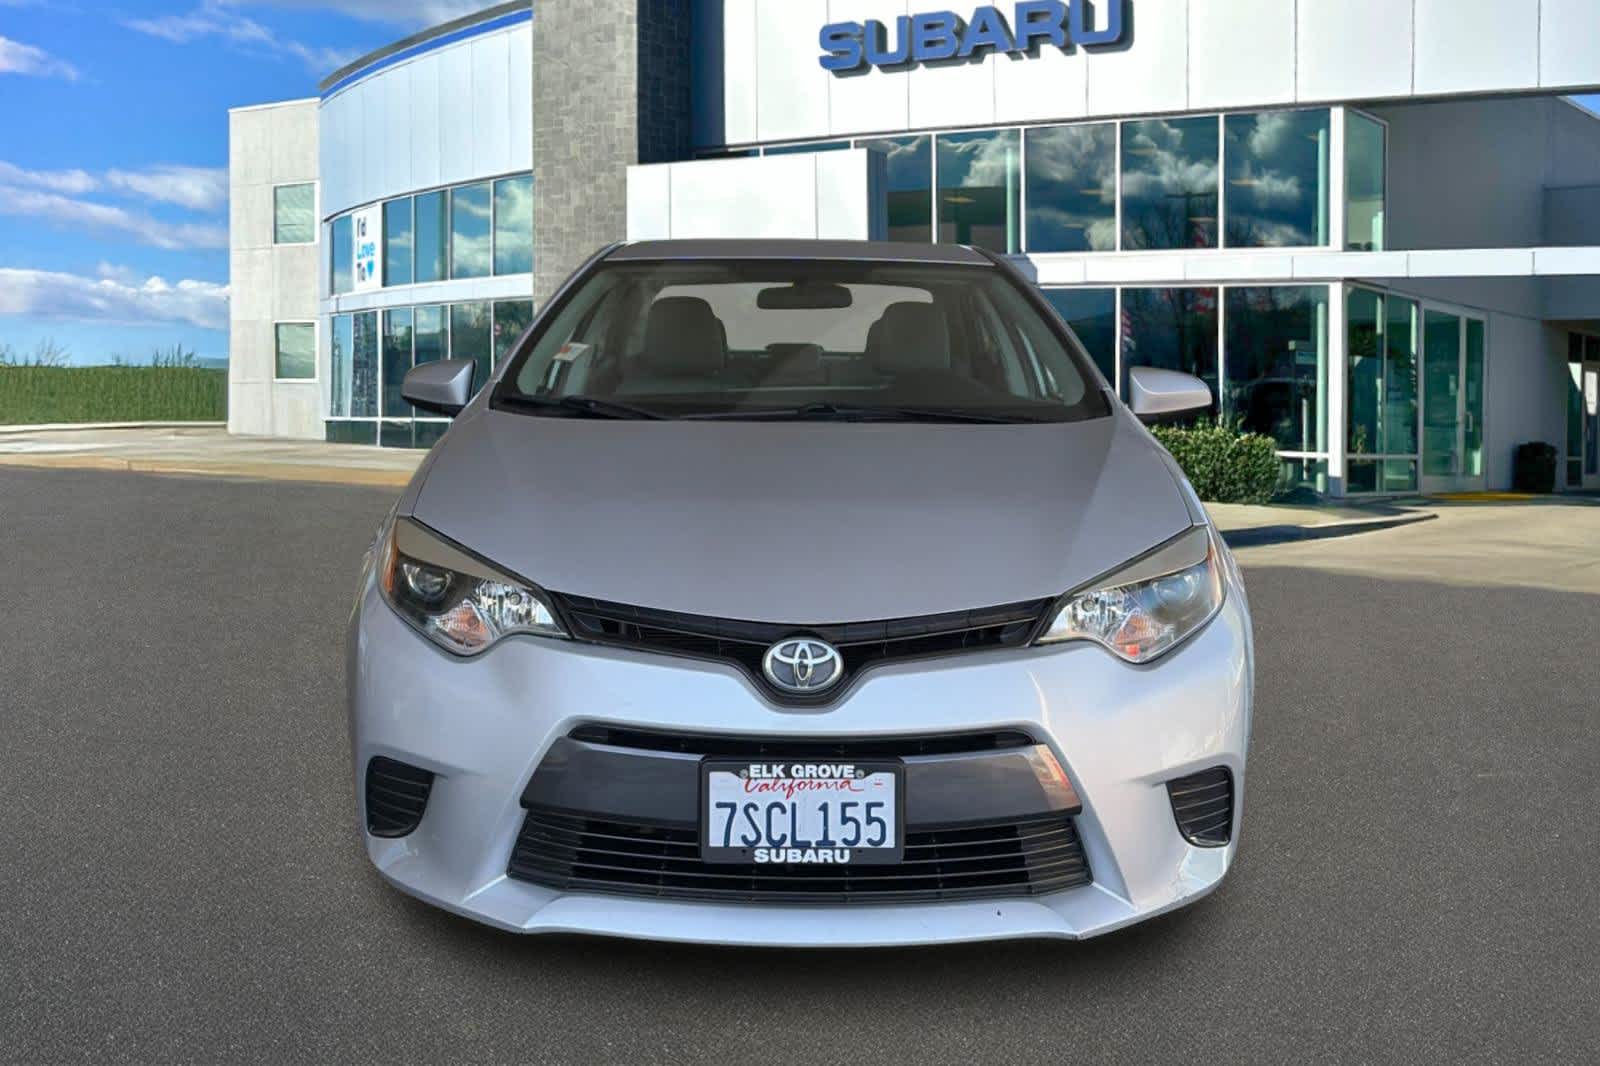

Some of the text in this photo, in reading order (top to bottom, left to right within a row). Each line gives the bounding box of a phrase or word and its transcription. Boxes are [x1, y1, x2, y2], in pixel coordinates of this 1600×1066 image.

[819, 0, 1132, 77] SUBARU
[749, 764, 856, 778] ELK GROVE
[743, 778, 865, 800] California
[715, 801, 887, 847] 7SCL155
[753, 848, 850, 864] SUBARU
